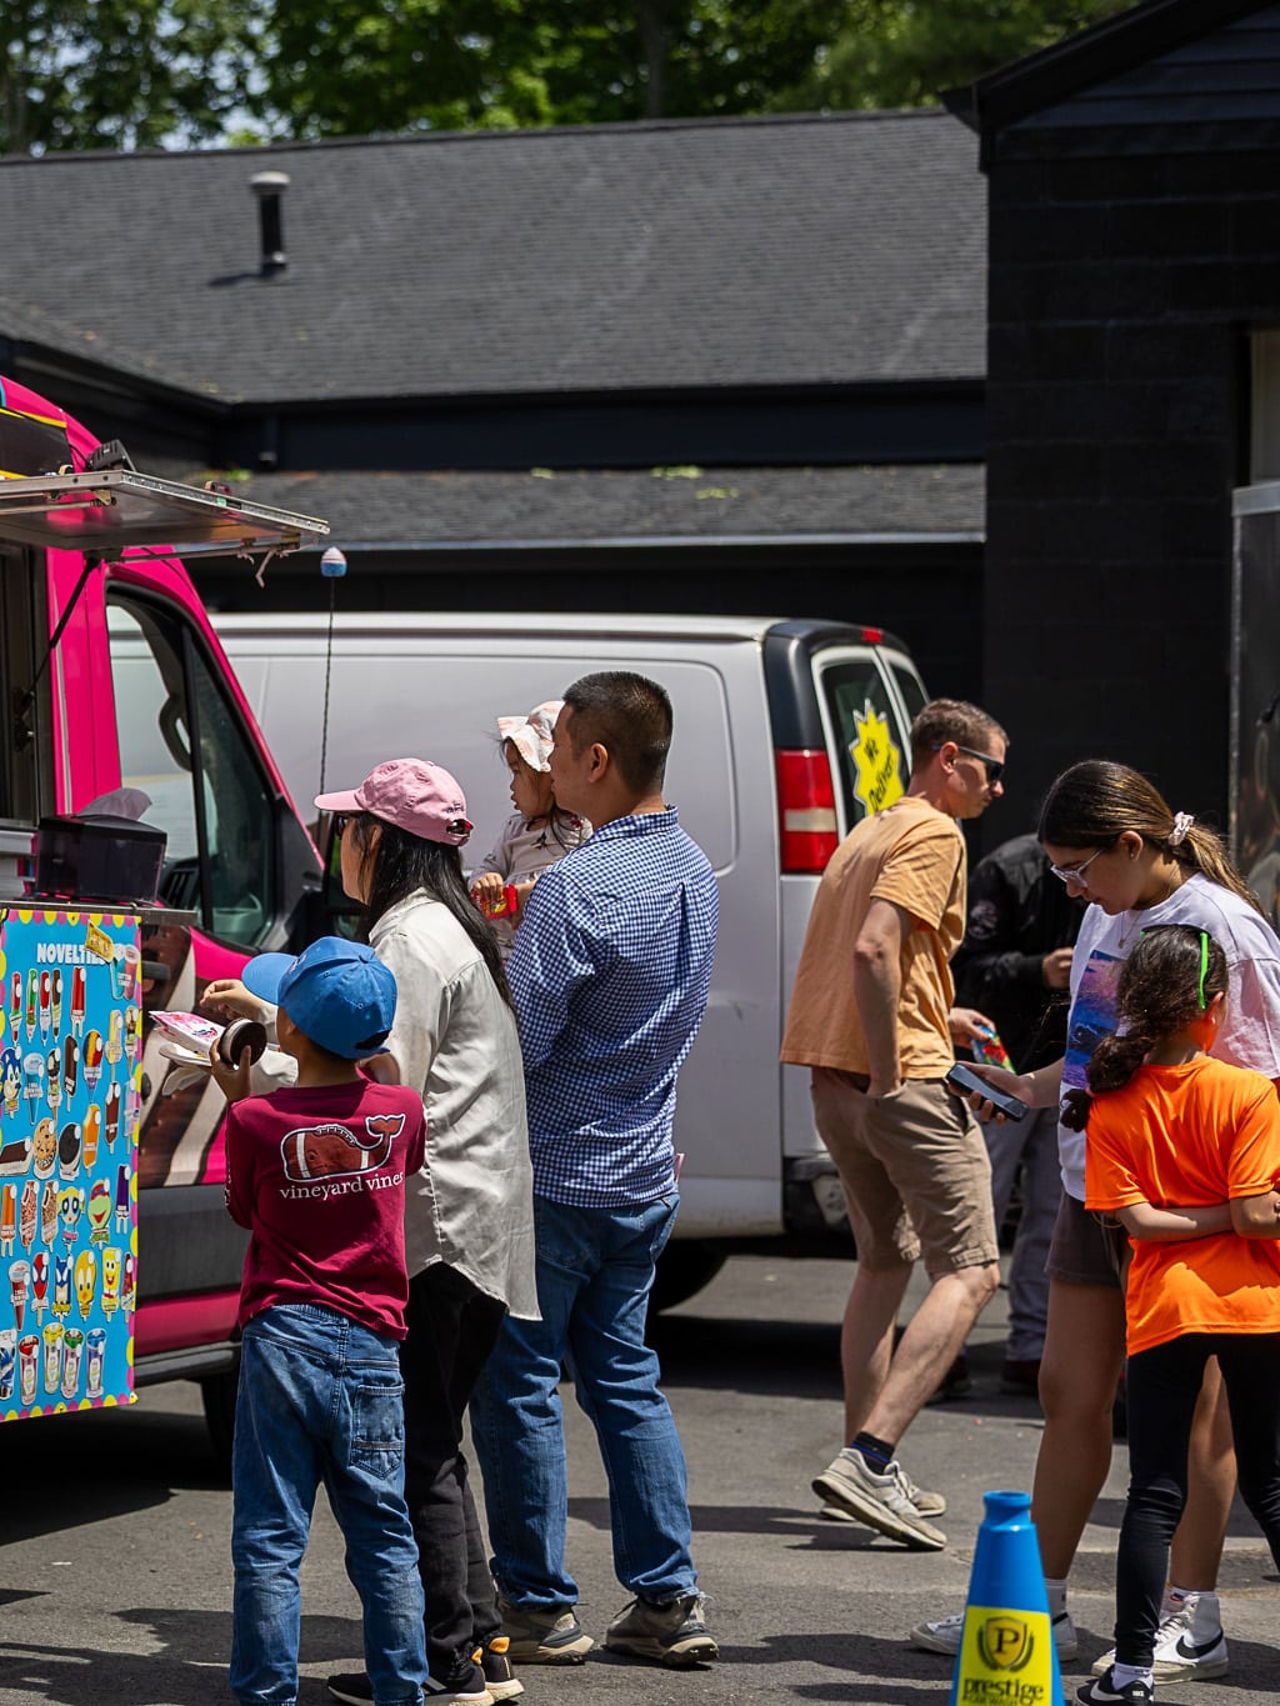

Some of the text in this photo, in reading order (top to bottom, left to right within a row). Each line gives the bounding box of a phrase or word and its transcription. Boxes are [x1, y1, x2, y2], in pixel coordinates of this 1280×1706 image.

[280, 1176, 364, 1201] vineyard
[994, 1626, 1020, 1654] P
[962, 1678, 1045, 1706] prestige
